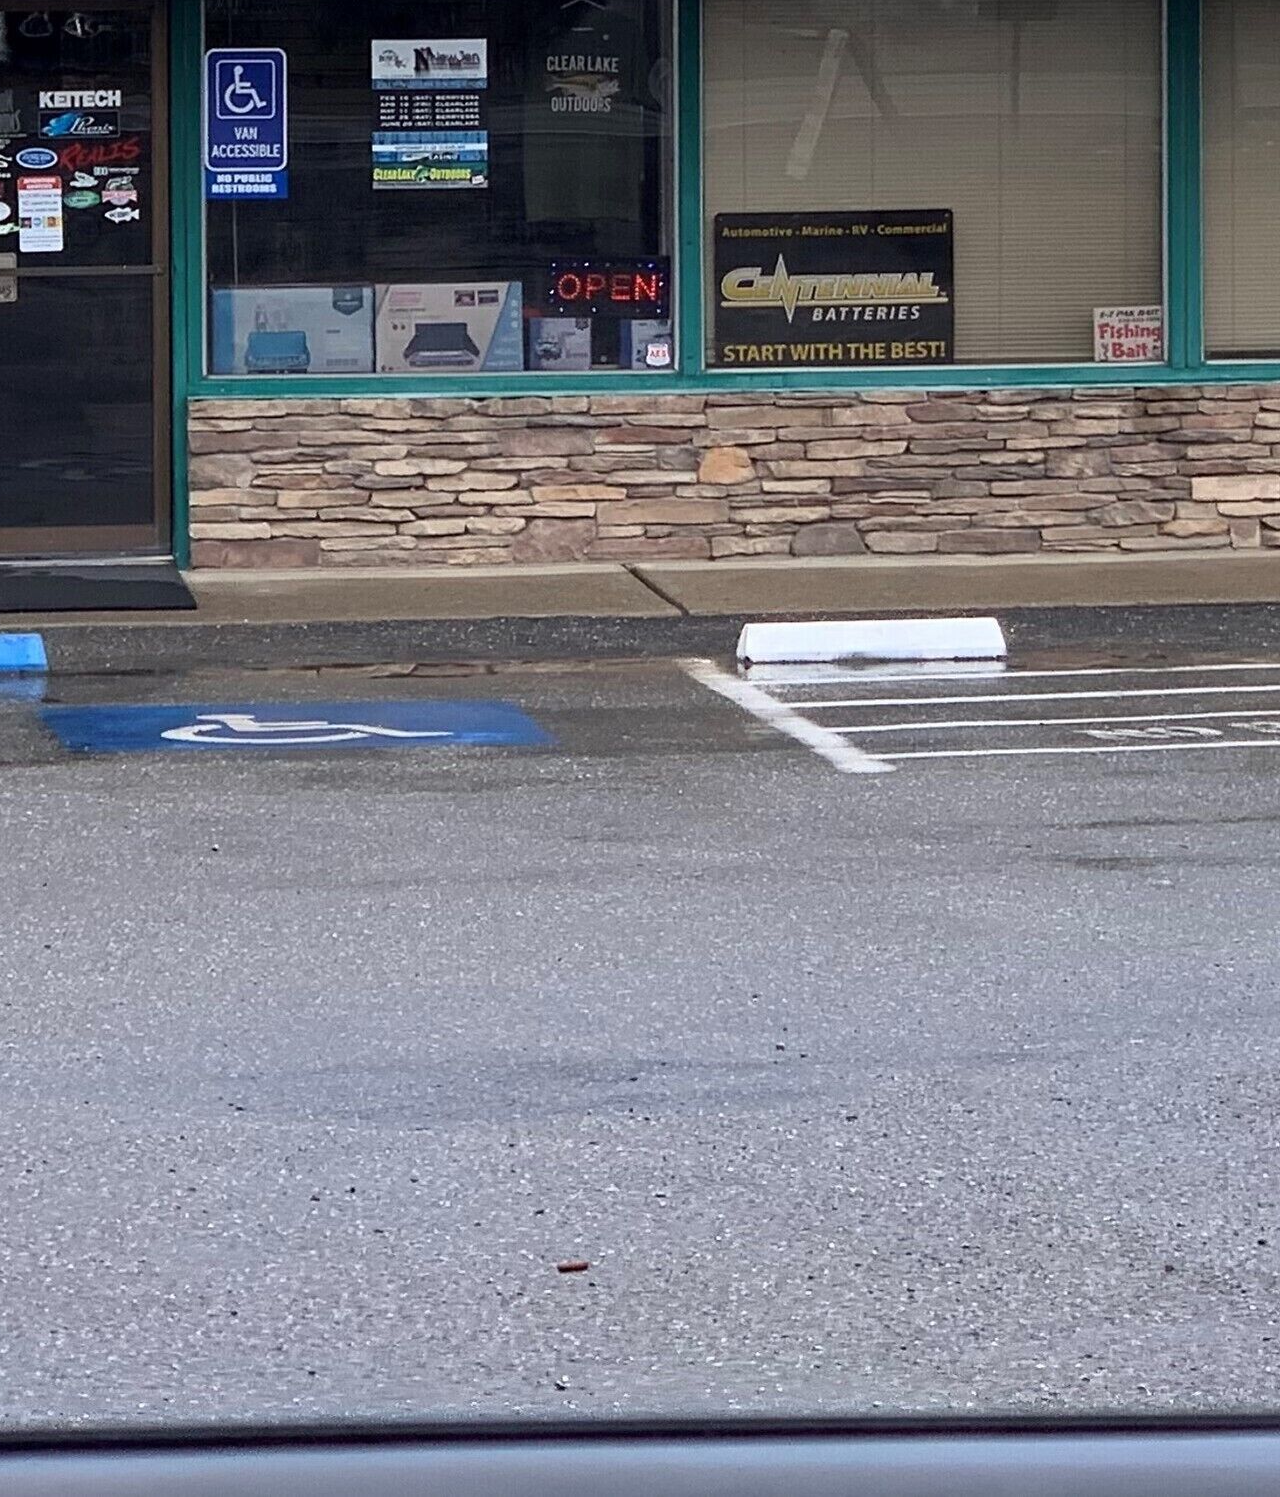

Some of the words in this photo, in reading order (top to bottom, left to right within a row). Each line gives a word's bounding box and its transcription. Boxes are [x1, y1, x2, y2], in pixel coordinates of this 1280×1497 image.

[546, 55, 586, 72] CLEAR
[586, 56, 619, 73] LAKE
[38, 90, 121, 108] KEITECH
[551, 96, 612, 113] OUTDOORS
[234, 127, 258, 140] VAN
[60, 138, 140, 170] REALIS
[211, 144, 280, 158] ACCESSIBLE
[216, 174, 232, 183] NO
[234, 174, 273, 183] PUBLIC
[429, 168, 471, 180] OUTDOORS
[211, 184, 277, 194] RESTROOMS
[722, 226, 793, 238] Automotive
[801, 225, 843, 236] Marine
[852, 225, 868, 235] RV
[877, 223, 947, 235] Commercial
[558, 273, 657, 300] OPEN
[721, 254, 939, 314] CENTENNIAL
[812, 306, 921, 321] BATTERIES
[1098, 323, 1161, 342] Fishing
[723, 345, 787, 362] START
[790, 344, 842, 361] WITH
[847, 343, 886, 359] THE
[890, 342, 945, 359] BEST!
[1111, 342, 1148, 358] Bait
